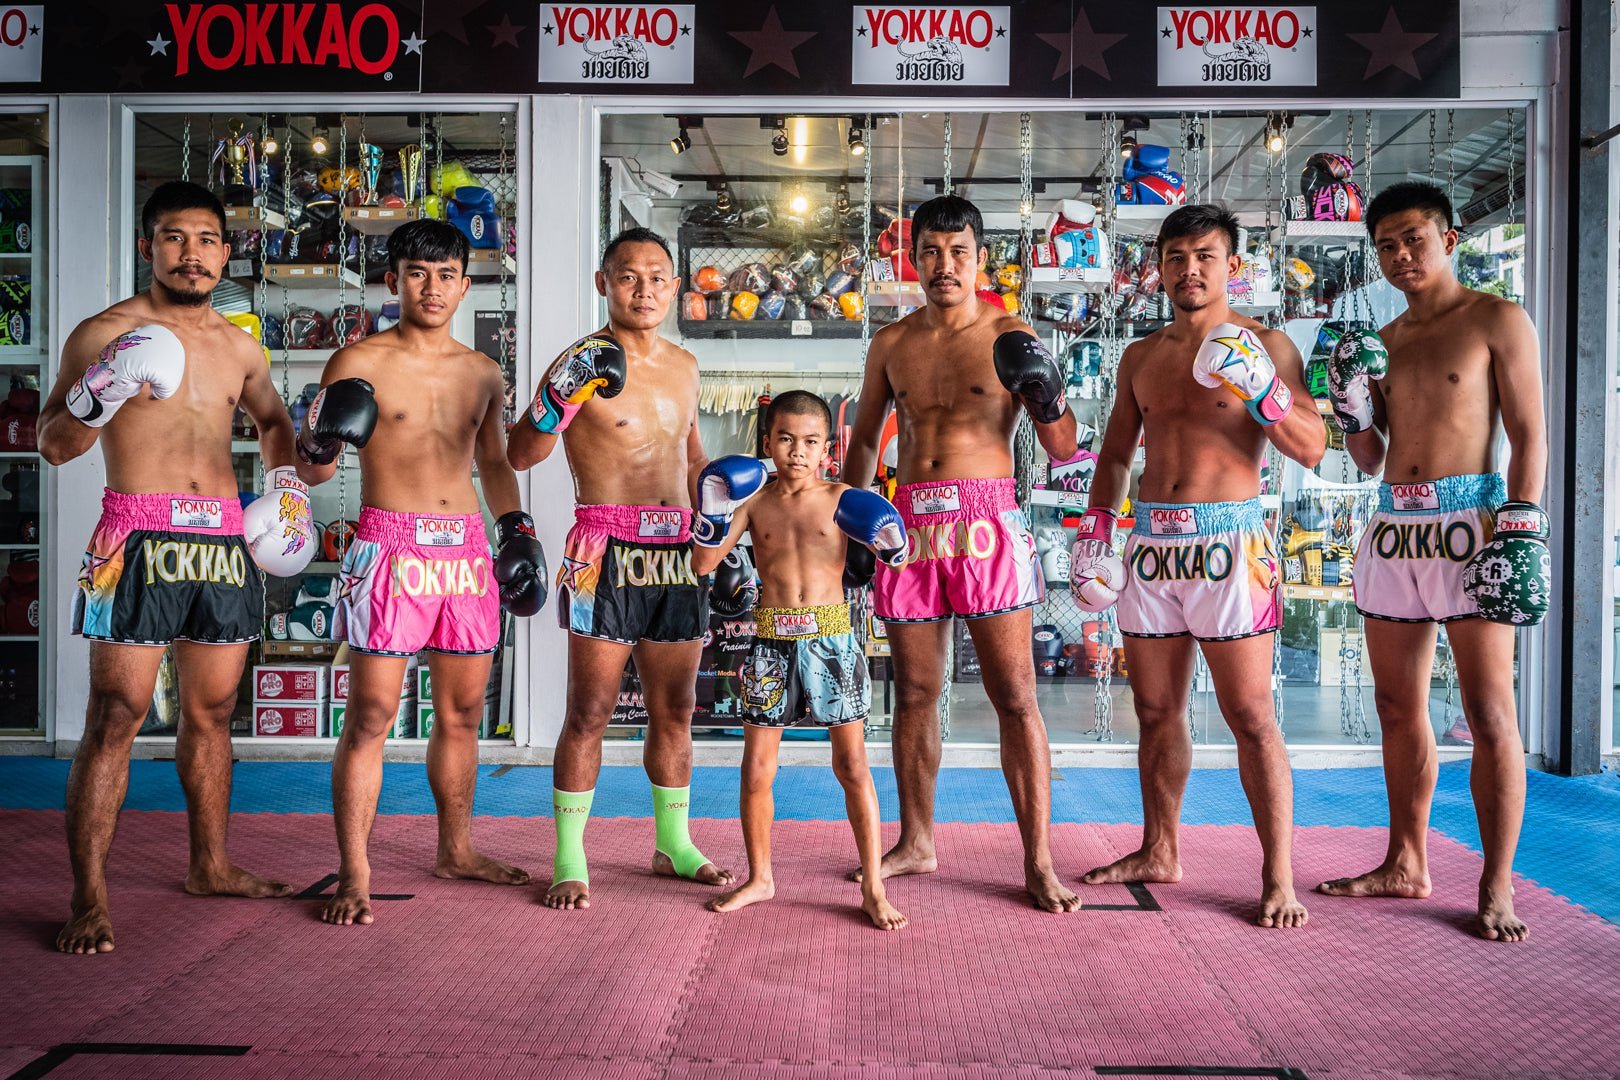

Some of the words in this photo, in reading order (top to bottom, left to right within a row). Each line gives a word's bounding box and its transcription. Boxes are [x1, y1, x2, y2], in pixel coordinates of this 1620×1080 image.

[552, 7, 678, 46] YOKKAO
[866, 9, 993, 48] YOKKAO
[1171, 10, 1299, 49] YOKKAO
[165, 3, 399, 77] YOKKAO
[915, 487, 953, 503] YOKKAO
[1394, 484, 1430, 498] YOKKAO
[177, 501, 218, 515] YOKKAO
[1153, 509, 1189, 522] YOKKAO
[645, 512, 680, 525] YOKKAO
[422, 519, 462, 534] YOKKAO
[906, 520, 996, 564] OKKAO
[143, 539, 246, 588] YOKKAO
[389, 555, 489, 598] YOKKAO
[777, 613, 812, 626] YOKKAO
[262, 680, 283, 690] PRO
[261, 717, 282, 727] PRO
